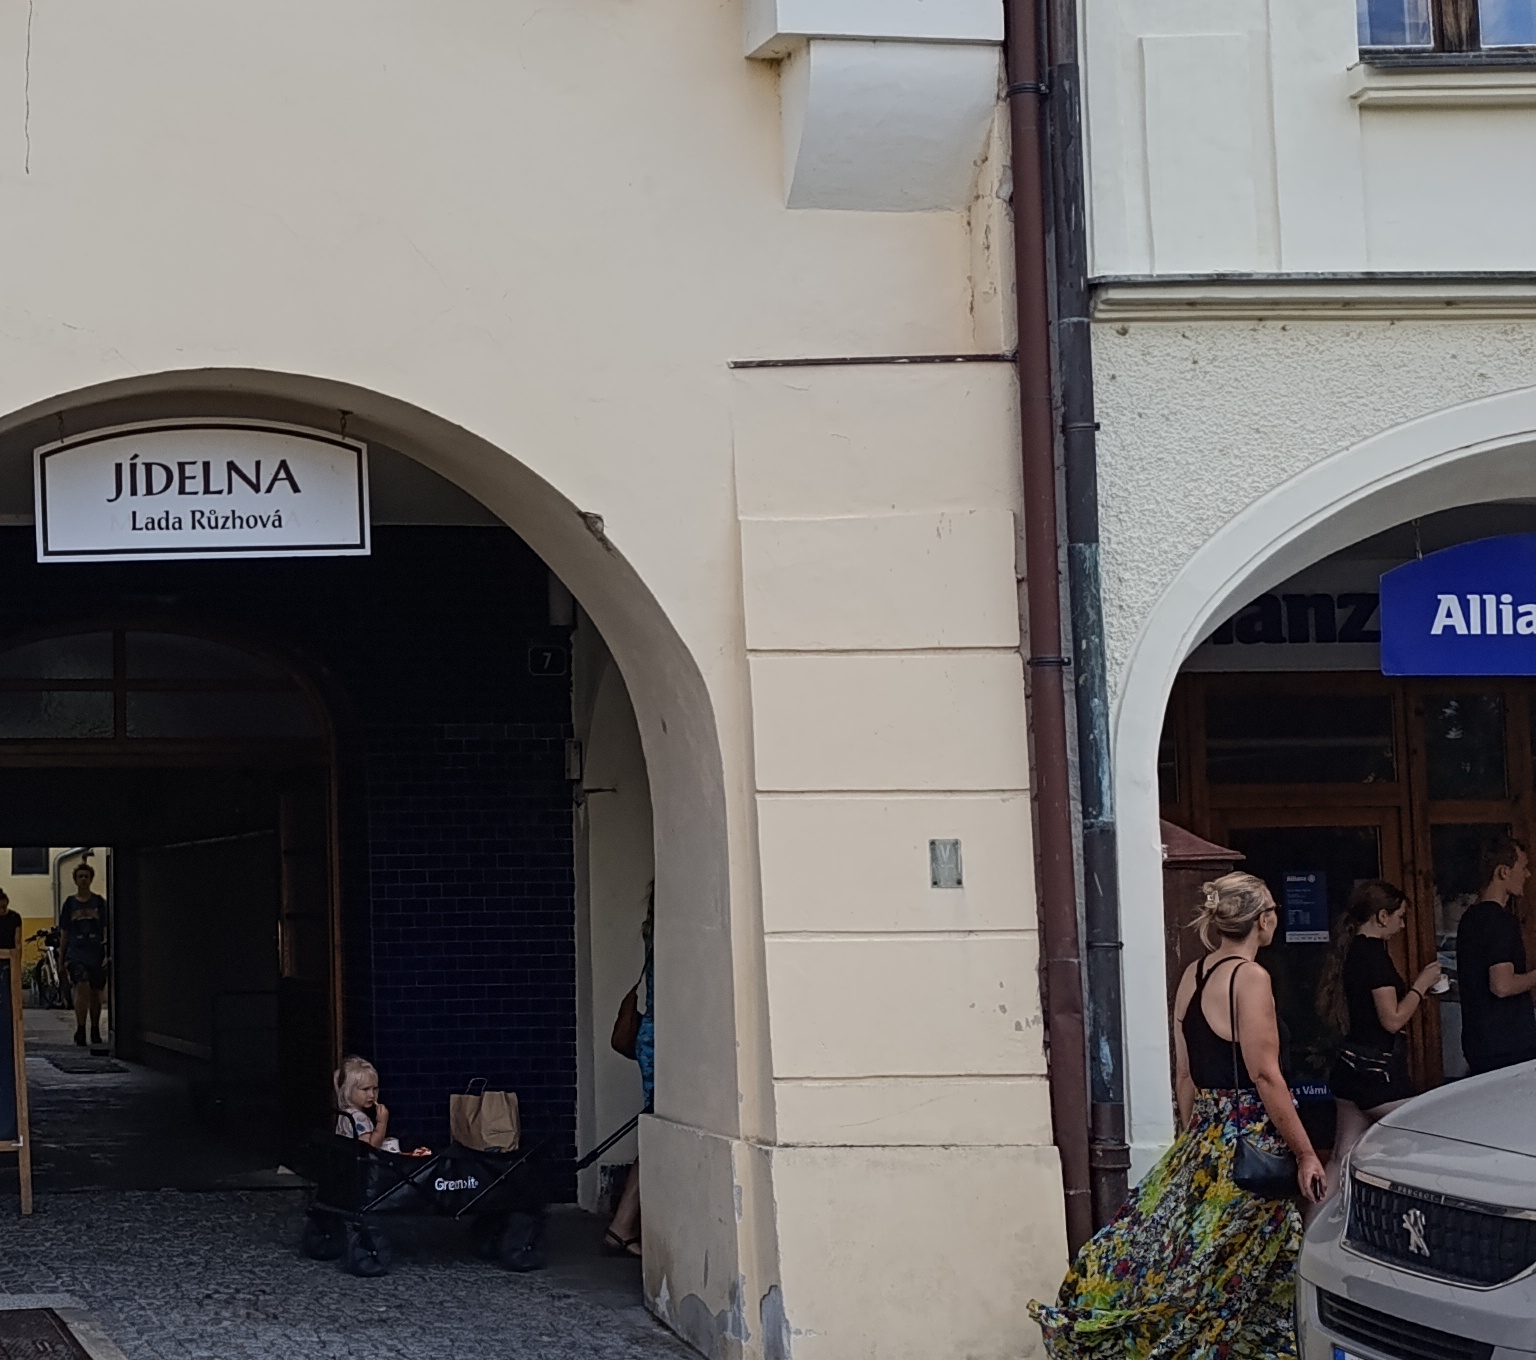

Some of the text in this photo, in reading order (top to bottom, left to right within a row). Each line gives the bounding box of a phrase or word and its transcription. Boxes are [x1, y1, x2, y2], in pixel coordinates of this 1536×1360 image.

[106, 454, 301, 502] JÍDELNA
[131, 508, 283, 531] Lada Růzhová
[542, 651, 552, 669] 7
[1397, 1185, 1436, 1200] PEUGEOT
